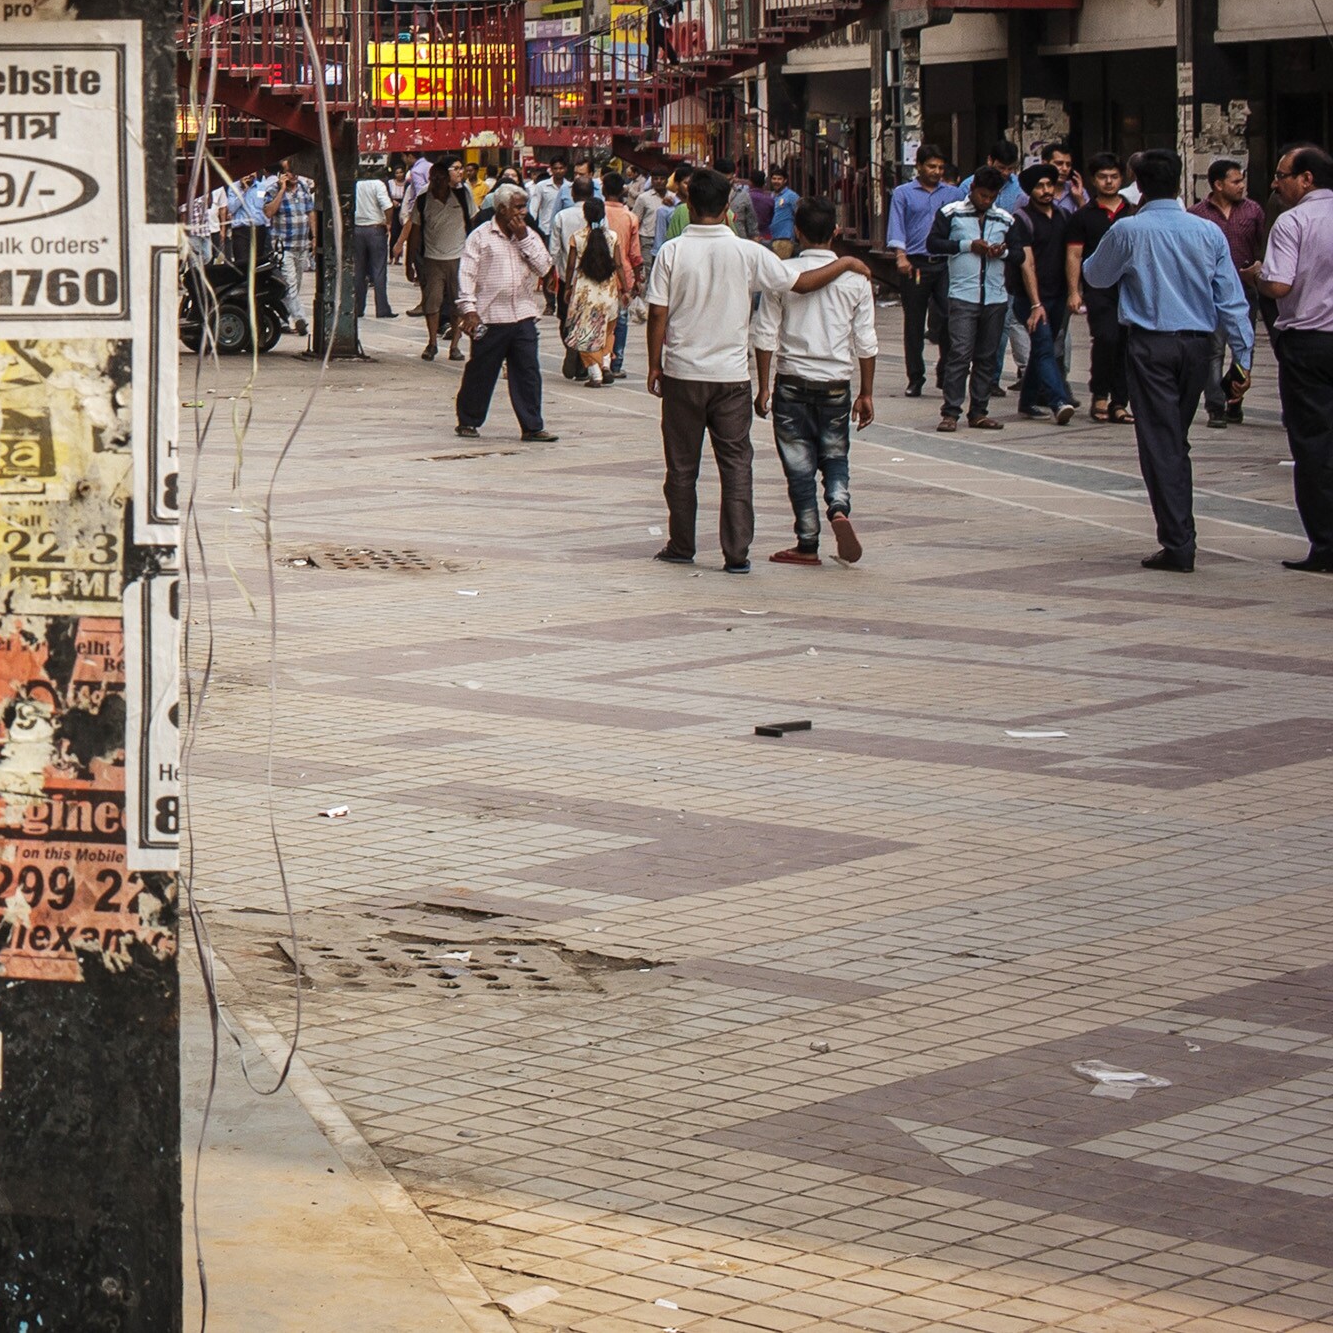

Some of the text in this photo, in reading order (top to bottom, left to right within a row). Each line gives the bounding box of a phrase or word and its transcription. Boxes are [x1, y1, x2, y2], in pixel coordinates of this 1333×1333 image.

[22, 847, 124, 864] on this Mobile
